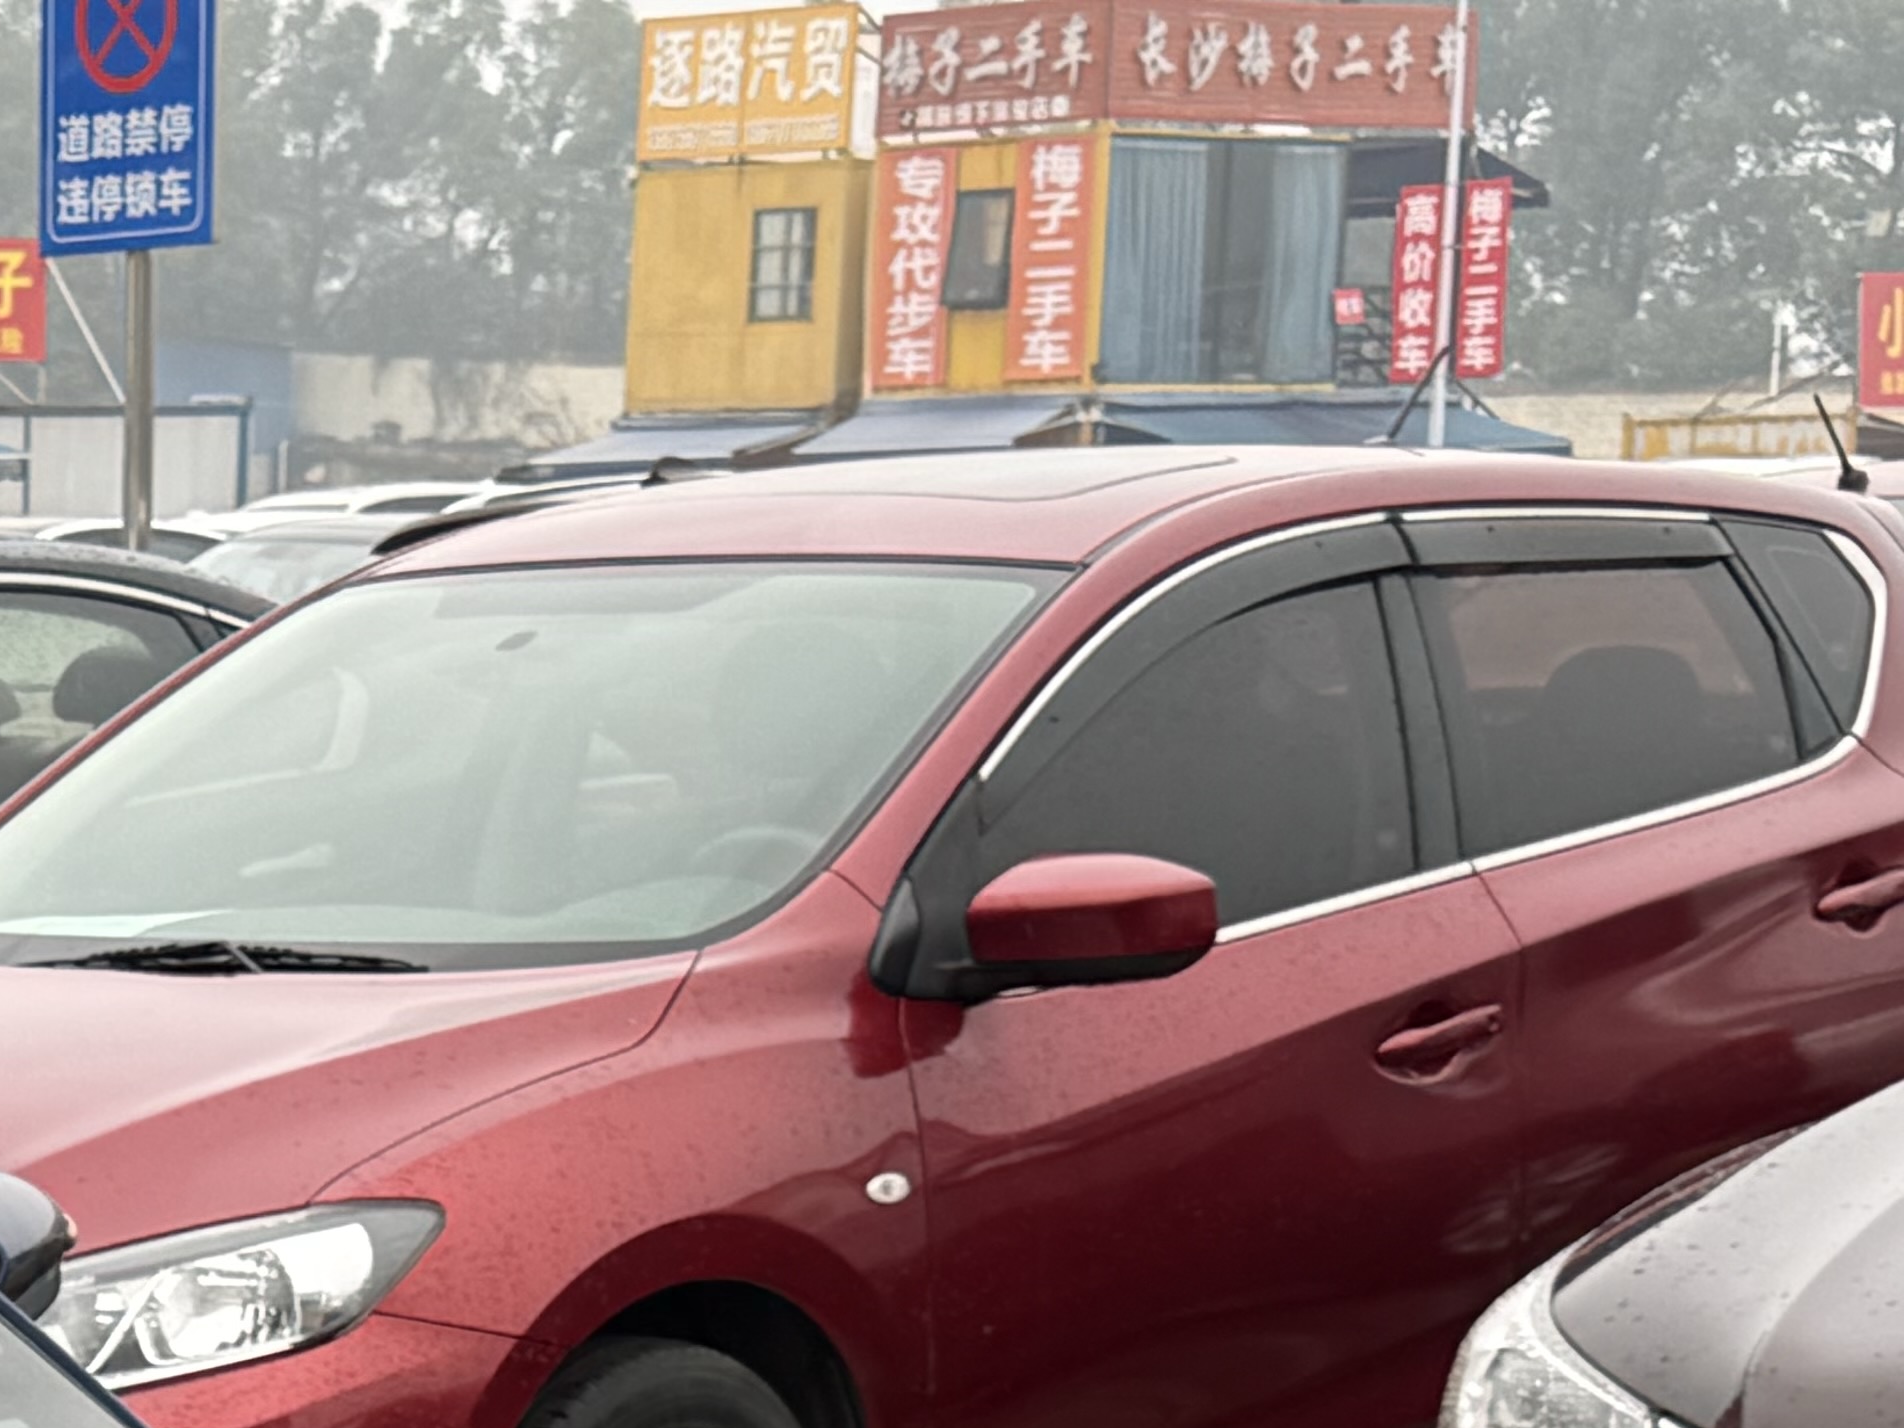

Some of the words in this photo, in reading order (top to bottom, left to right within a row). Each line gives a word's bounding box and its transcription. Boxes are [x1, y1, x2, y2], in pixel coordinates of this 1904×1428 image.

[882, 11, 1093, 96] 梅子二手车
[1137, 9, 1459, 95] 长沙梅子二手车
[57, 103, 193, 162] 道路禁停
[57, 166, 192, 223] 违停锁车
[883, 155, 944, 381] 专攻代步车
[1019, 144, 1083, 373] 梅子二手车
[1394, 193, 1440, 375] 高价收车
[1459, 188, 1502, 371] 梅子二手车
